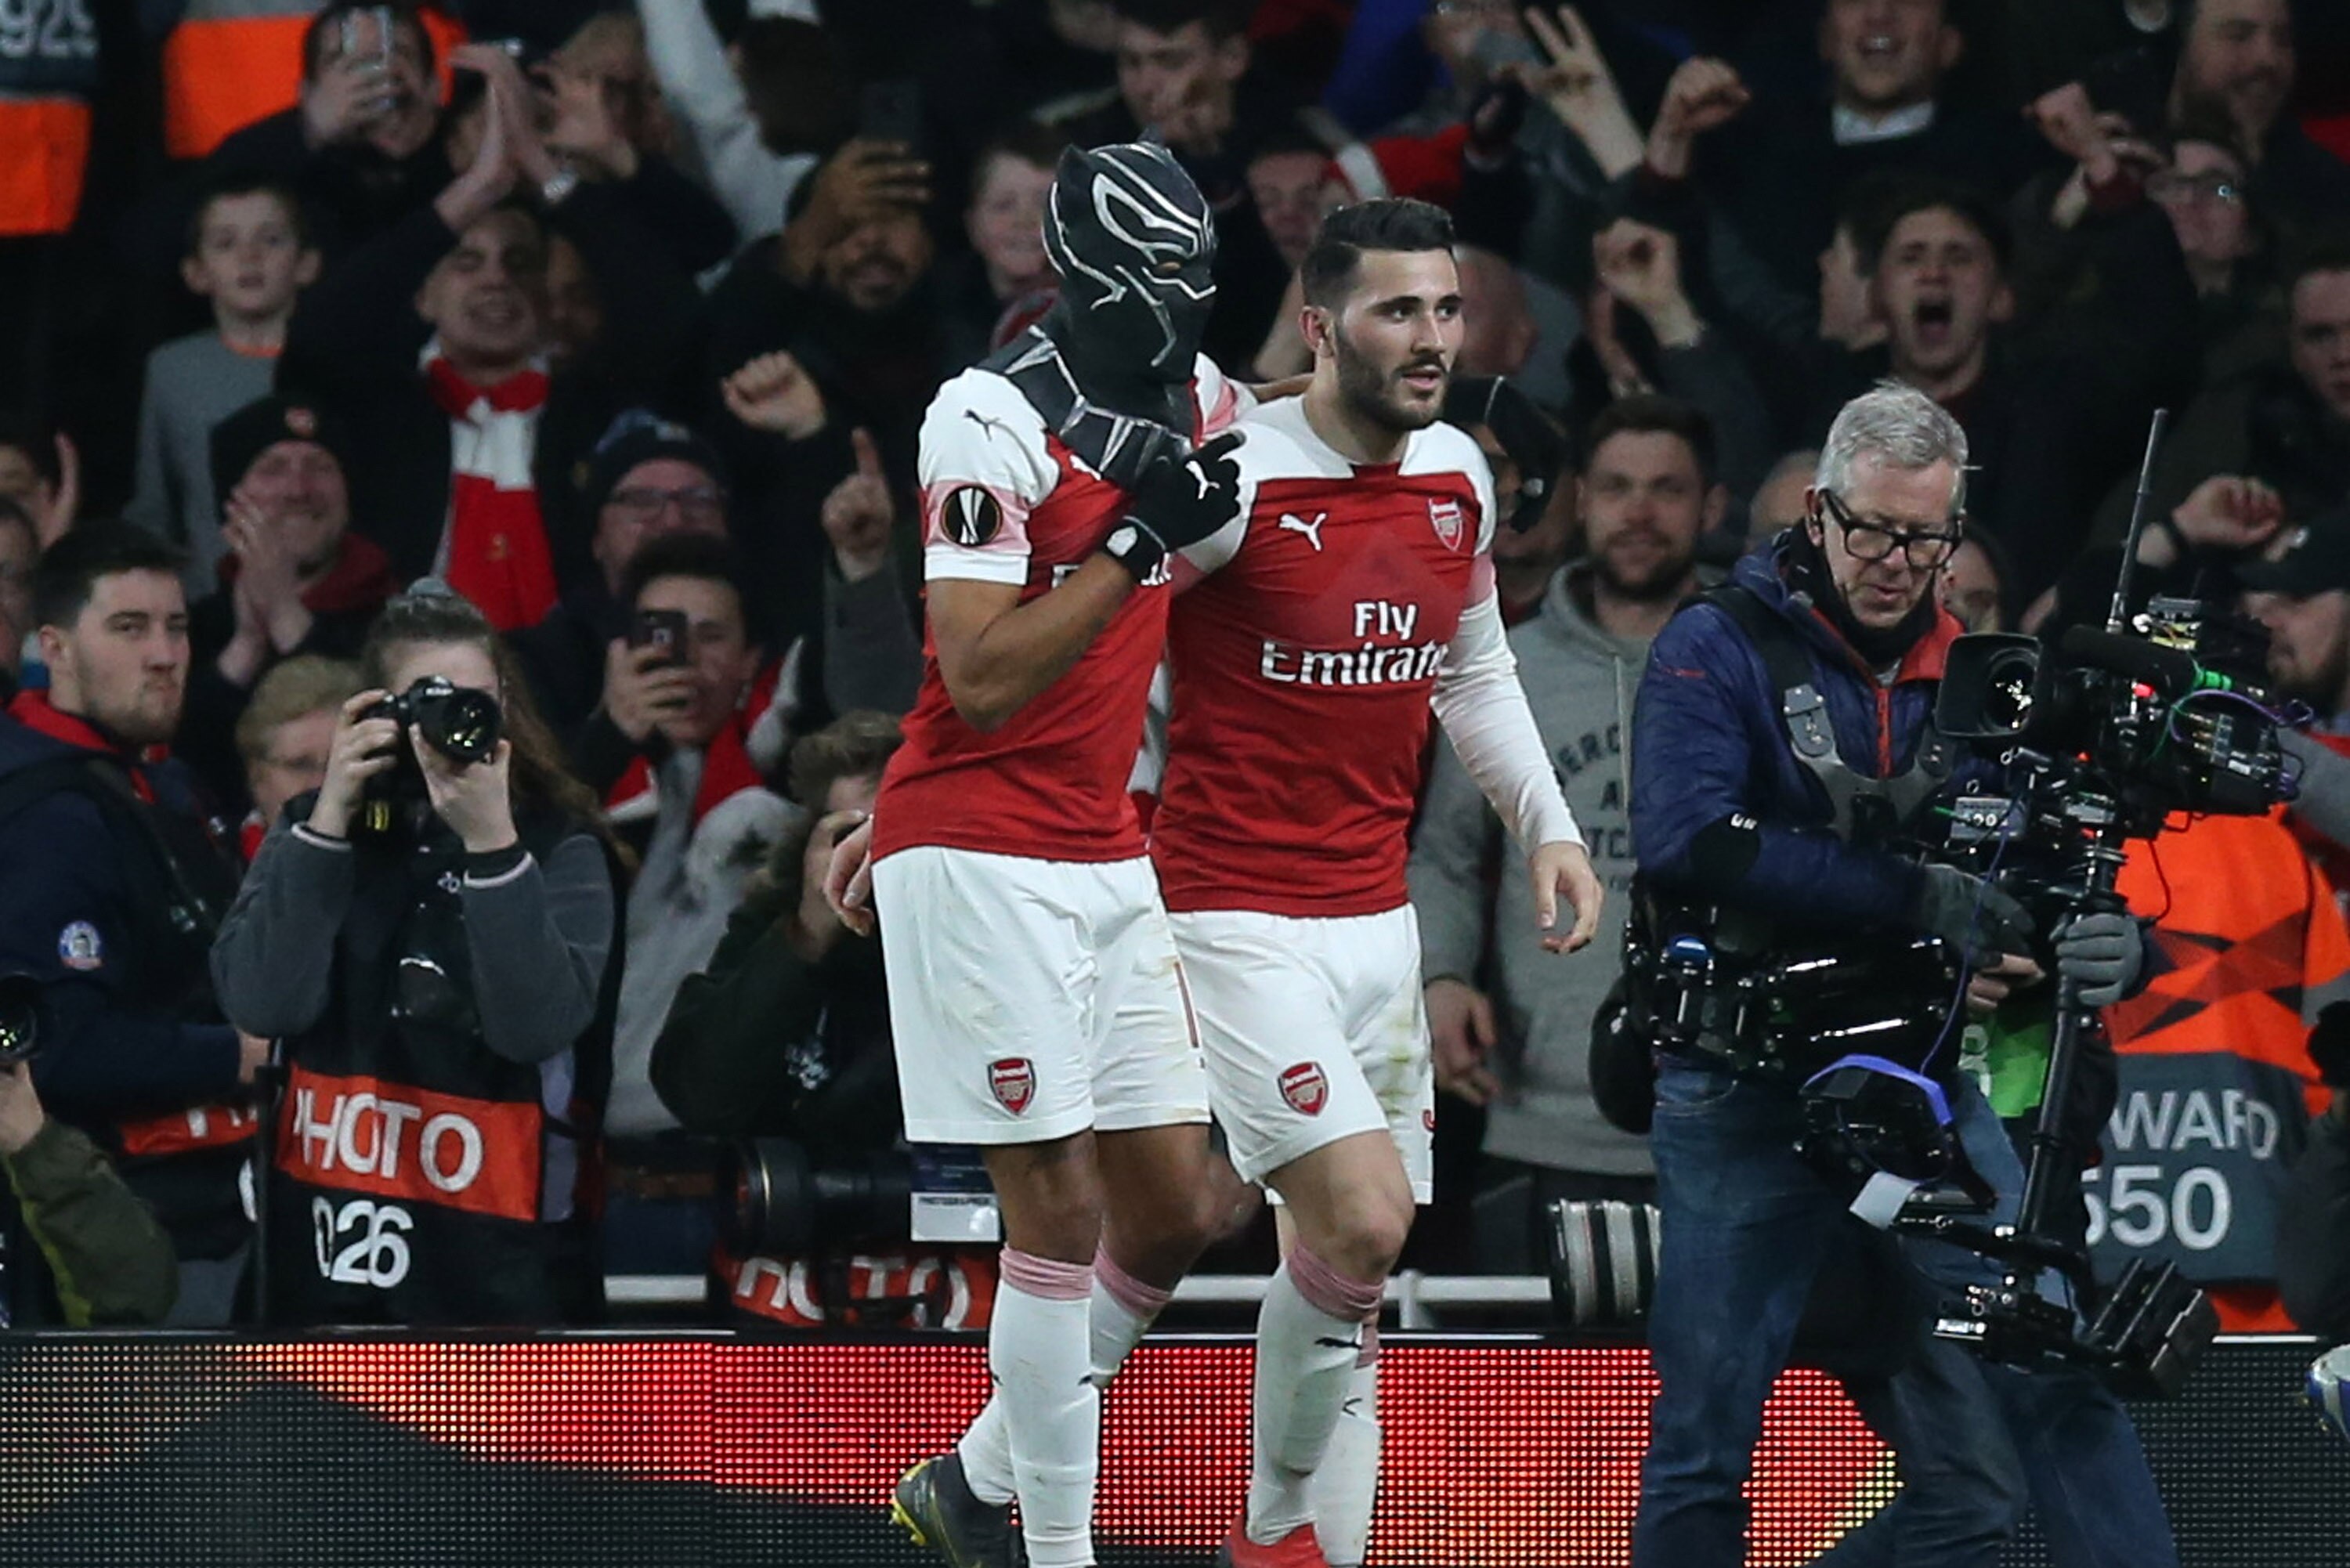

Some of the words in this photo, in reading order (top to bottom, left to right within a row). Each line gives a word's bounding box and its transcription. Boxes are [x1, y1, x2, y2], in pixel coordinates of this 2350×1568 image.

[1354, 601, 1417, 641] Fly
[1261, 640, 1448, 686] Emirate
[313, 1195, 414, 1288] 026
